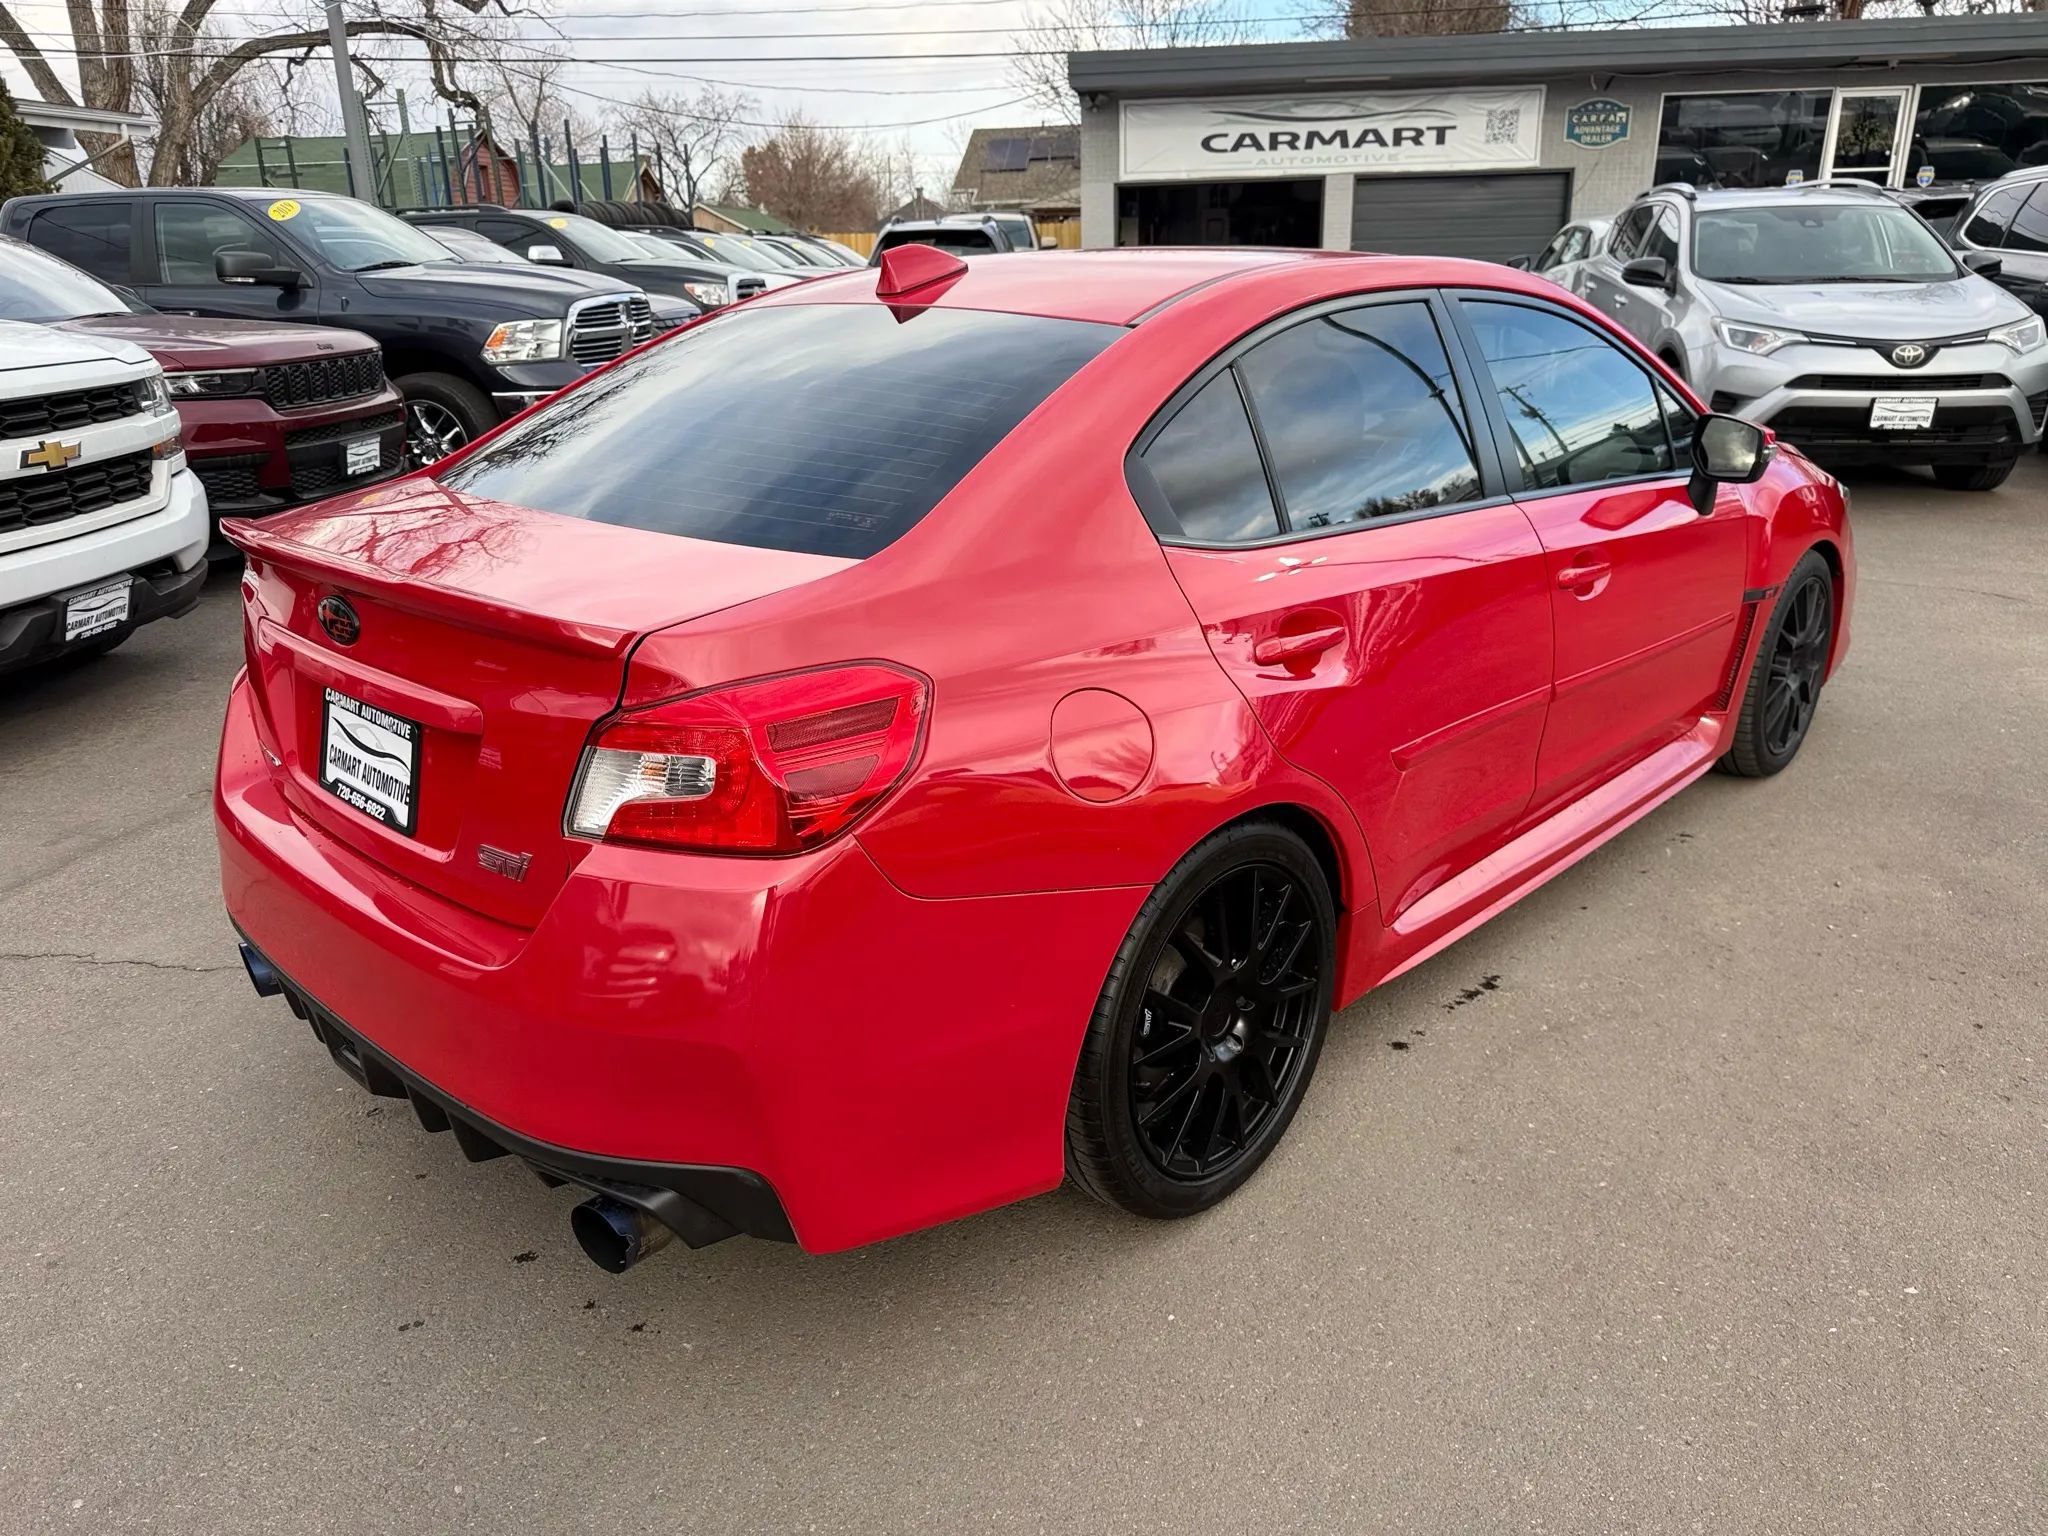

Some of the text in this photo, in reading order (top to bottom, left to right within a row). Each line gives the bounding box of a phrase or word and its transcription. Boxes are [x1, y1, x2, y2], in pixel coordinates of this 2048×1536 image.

[1201, 125, 1457, 154] CARMART
[1573, 125, 1621, 134] ADVANTAGE
[1581, 134, 1613, 144] DEALER
[1255, 152, 1401, 167] AUTOMOTIVE
[68, 590, 98, 606] CARMART
[66, 603, 127, 632] CARMART AUTOMOTIVE
[325, 687, 412, 739] CARMART AUTOMOTIVE
[329, 744, 411, 808] CARMART AUTOMOTIVE
[336, 783, 386, 821] 720-656-6922
